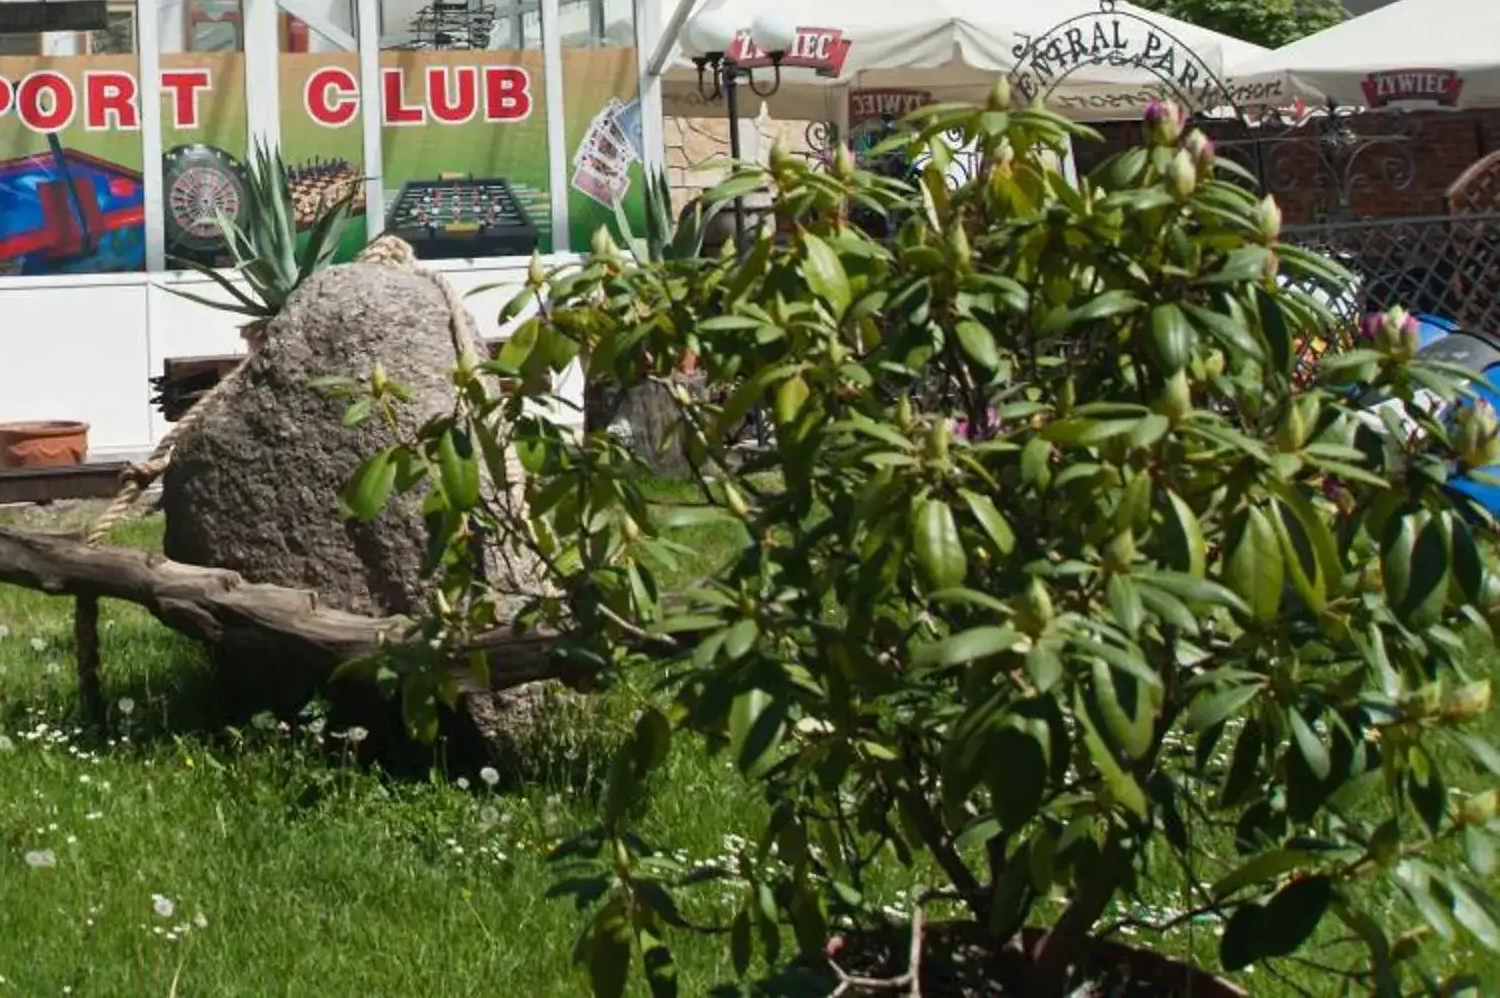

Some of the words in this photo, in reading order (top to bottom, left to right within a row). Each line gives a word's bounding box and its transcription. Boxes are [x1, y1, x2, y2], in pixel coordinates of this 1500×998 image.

[737, 32, 833, 60] ŻIEC
[1012, 19, 1128, 103] ENTRAL
[304, 64, 532, 128] CLUB
